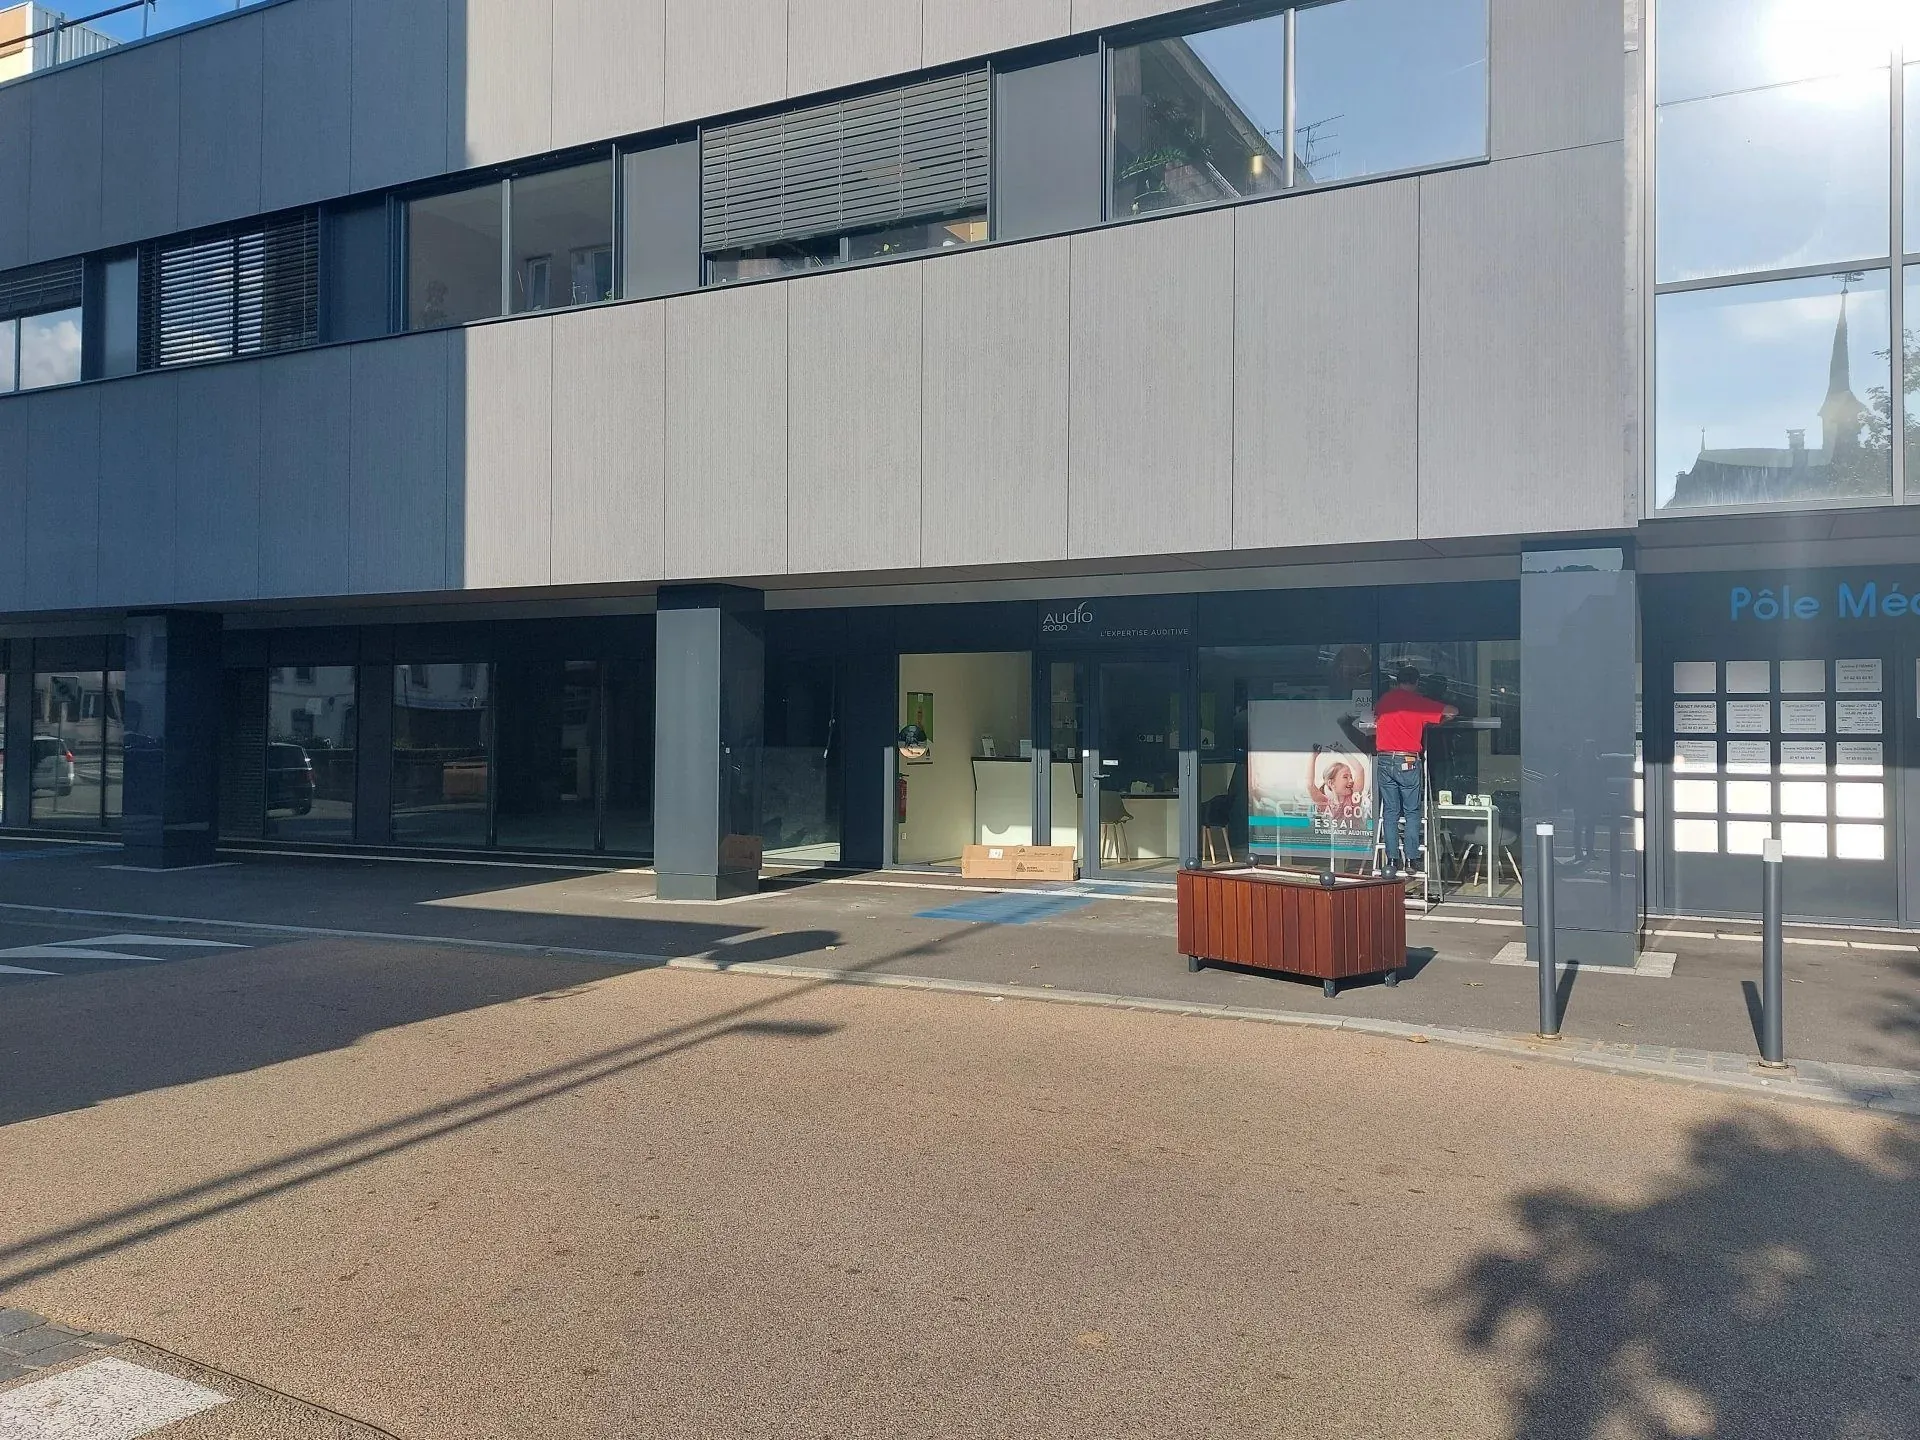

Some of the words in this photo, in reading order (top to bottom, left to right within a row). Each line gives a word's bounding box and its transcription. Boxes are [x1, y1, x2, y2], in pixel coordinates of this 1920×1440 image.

[1731, 585, 1821, 621] Pôle
[1100, 629, 1148, 637] L'EXPERTISE
[1151, 628, 1189, 636] AUDITIVE
[1314, 819, 1353, 829] ESSAI
[1348, 829, 1374, 837] AUDITIVE
